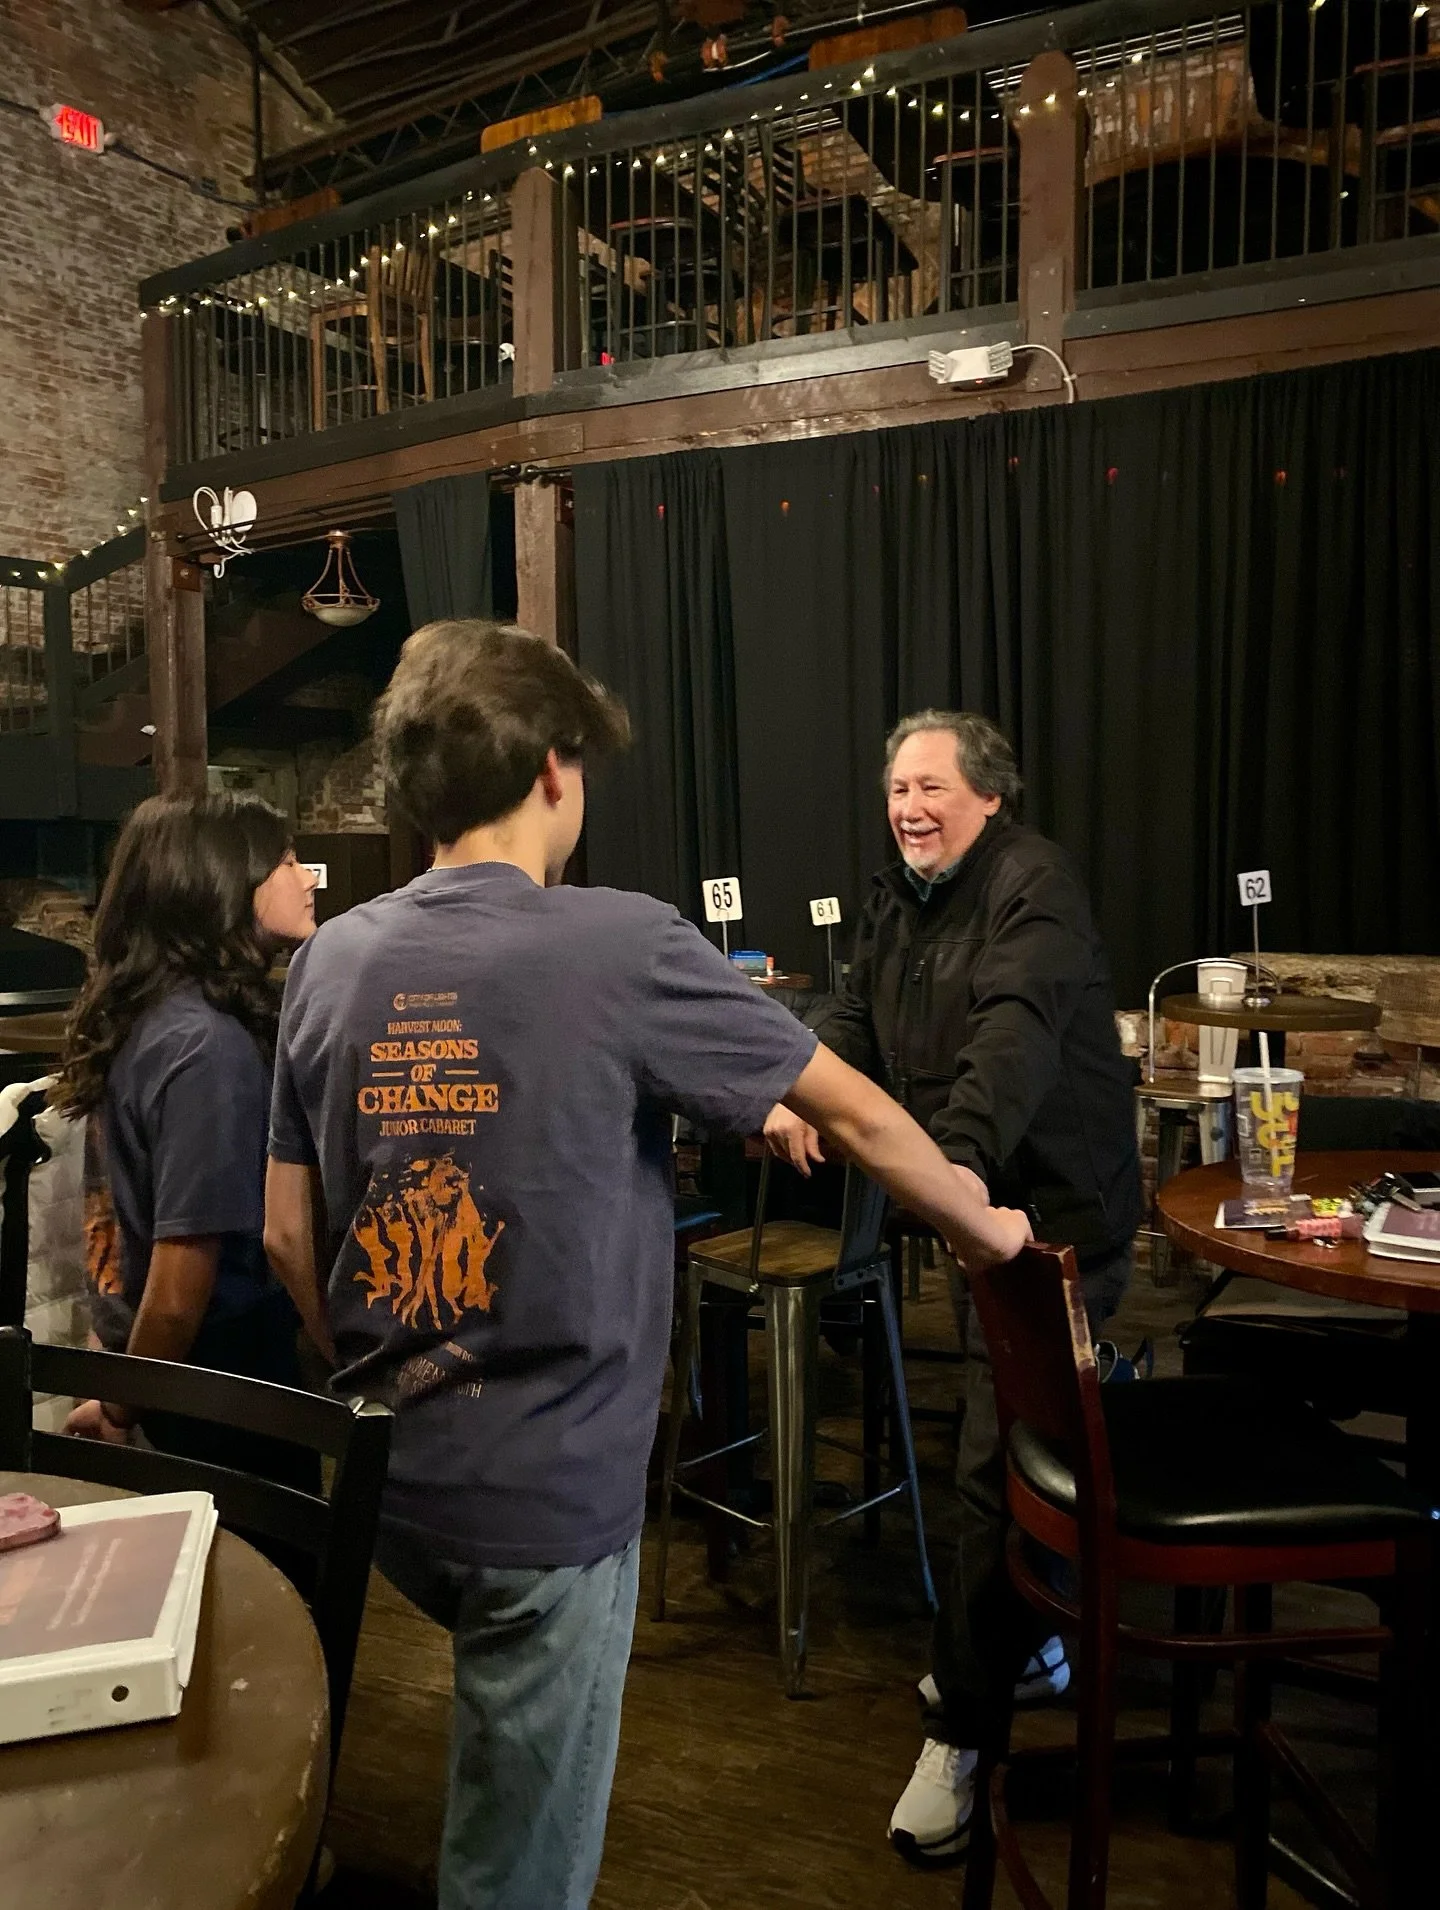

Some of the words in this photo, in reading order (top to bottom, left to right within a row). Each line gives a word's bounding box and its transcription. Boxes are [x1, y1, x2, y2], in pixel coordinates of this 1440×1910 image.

[62, 105, 97, 148] EXIT
[712, 882, 732, 908] 65
[1246, 877, 1266, 899] 62
[817, 899, 834, 917] 61
[388, 1021, 430, 1035] HARVEST
[370, 1039, 479, 1062] SEASONS
[410, 1064, 437, 1083] OF
[358, 1084, 499, 1114] CHANGE
[380, 1120, 418, 1137] JUNIOR
[420, 1118, 477, 1136] CABARET
